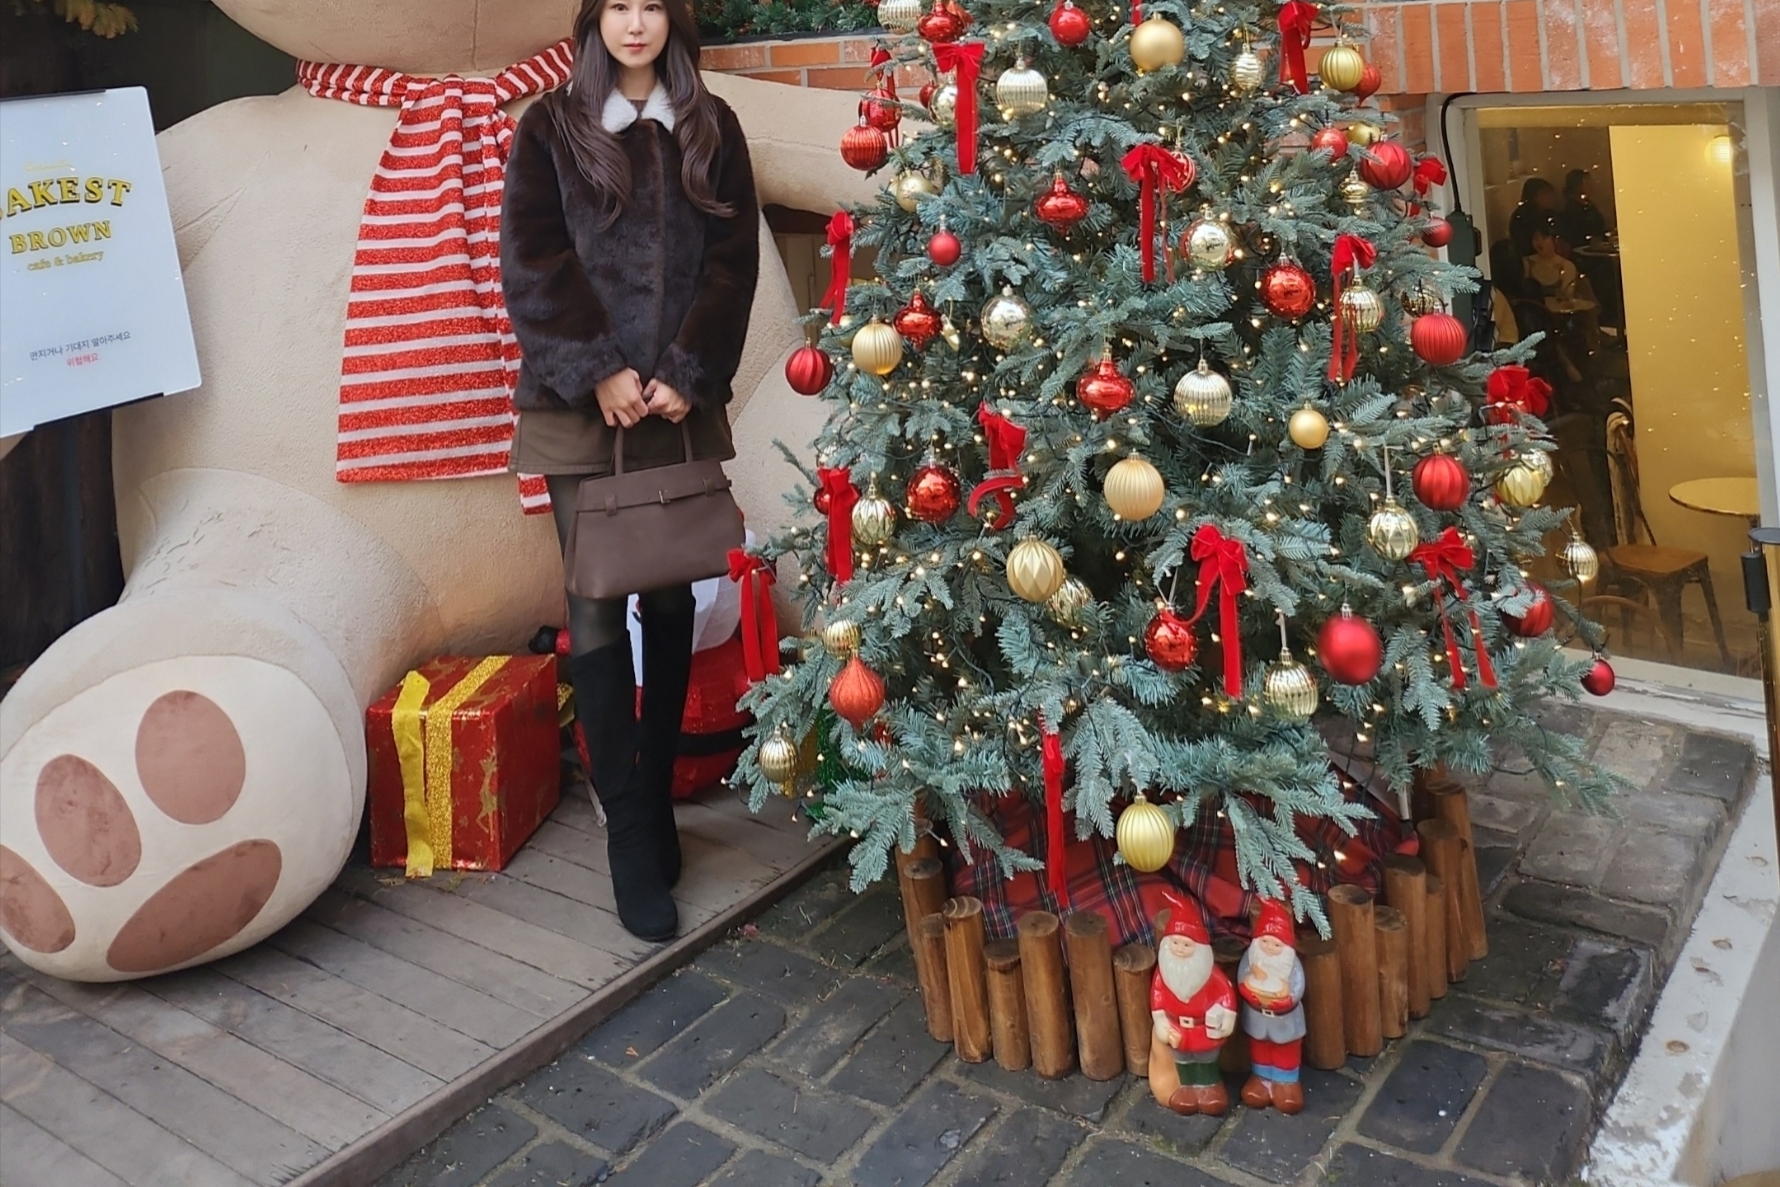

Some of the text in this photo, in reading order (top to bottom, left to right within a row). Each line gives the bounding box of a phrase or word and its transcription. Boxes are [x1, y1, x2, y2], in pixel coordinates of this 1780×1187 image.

[0, 176, 131, 220] AKEST
[9, 220, 112, 254] BROWN
[27, 251, 104, 271] cafe & bakery
[29, 331, 131, 361] 만지거나 기대지 말아주세요
